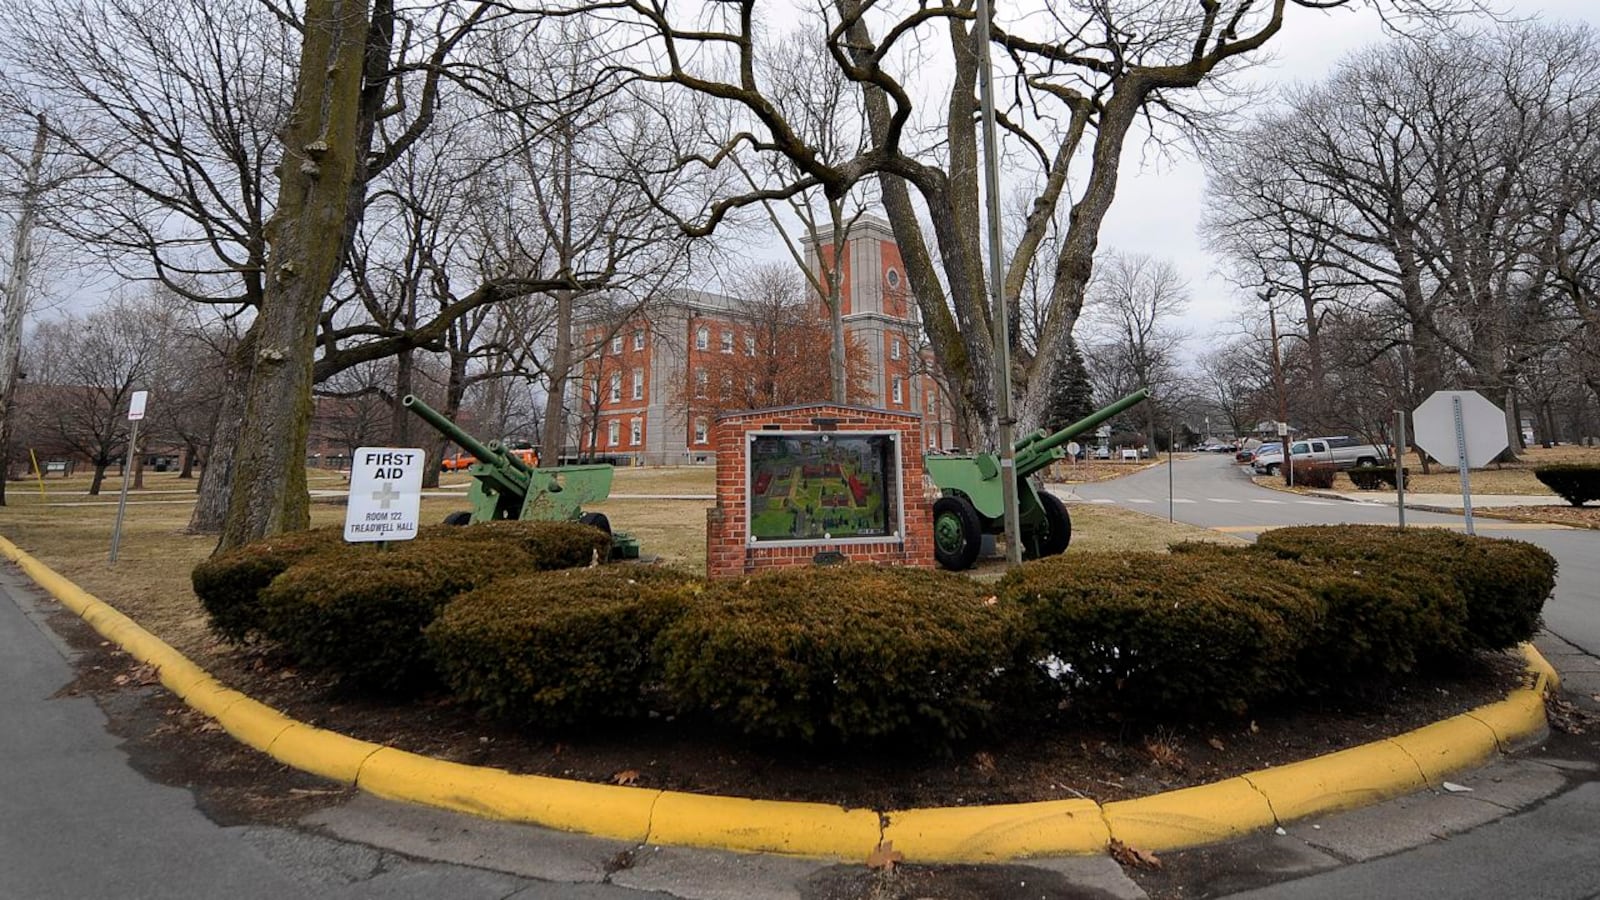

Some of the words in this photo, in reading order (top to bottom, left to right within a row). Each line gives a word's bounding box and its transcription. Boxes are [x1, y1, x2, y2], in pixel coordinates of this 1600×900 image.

[365, 454, 414, 465] FIRST
[374, 468, 403, 479] AID
[366, 513, 388, 521] ROOM
[391, 512, 402, 520] 122
[350, 524, 394, 533] TREADWELL
[396, 522, 414, 531] HALL
